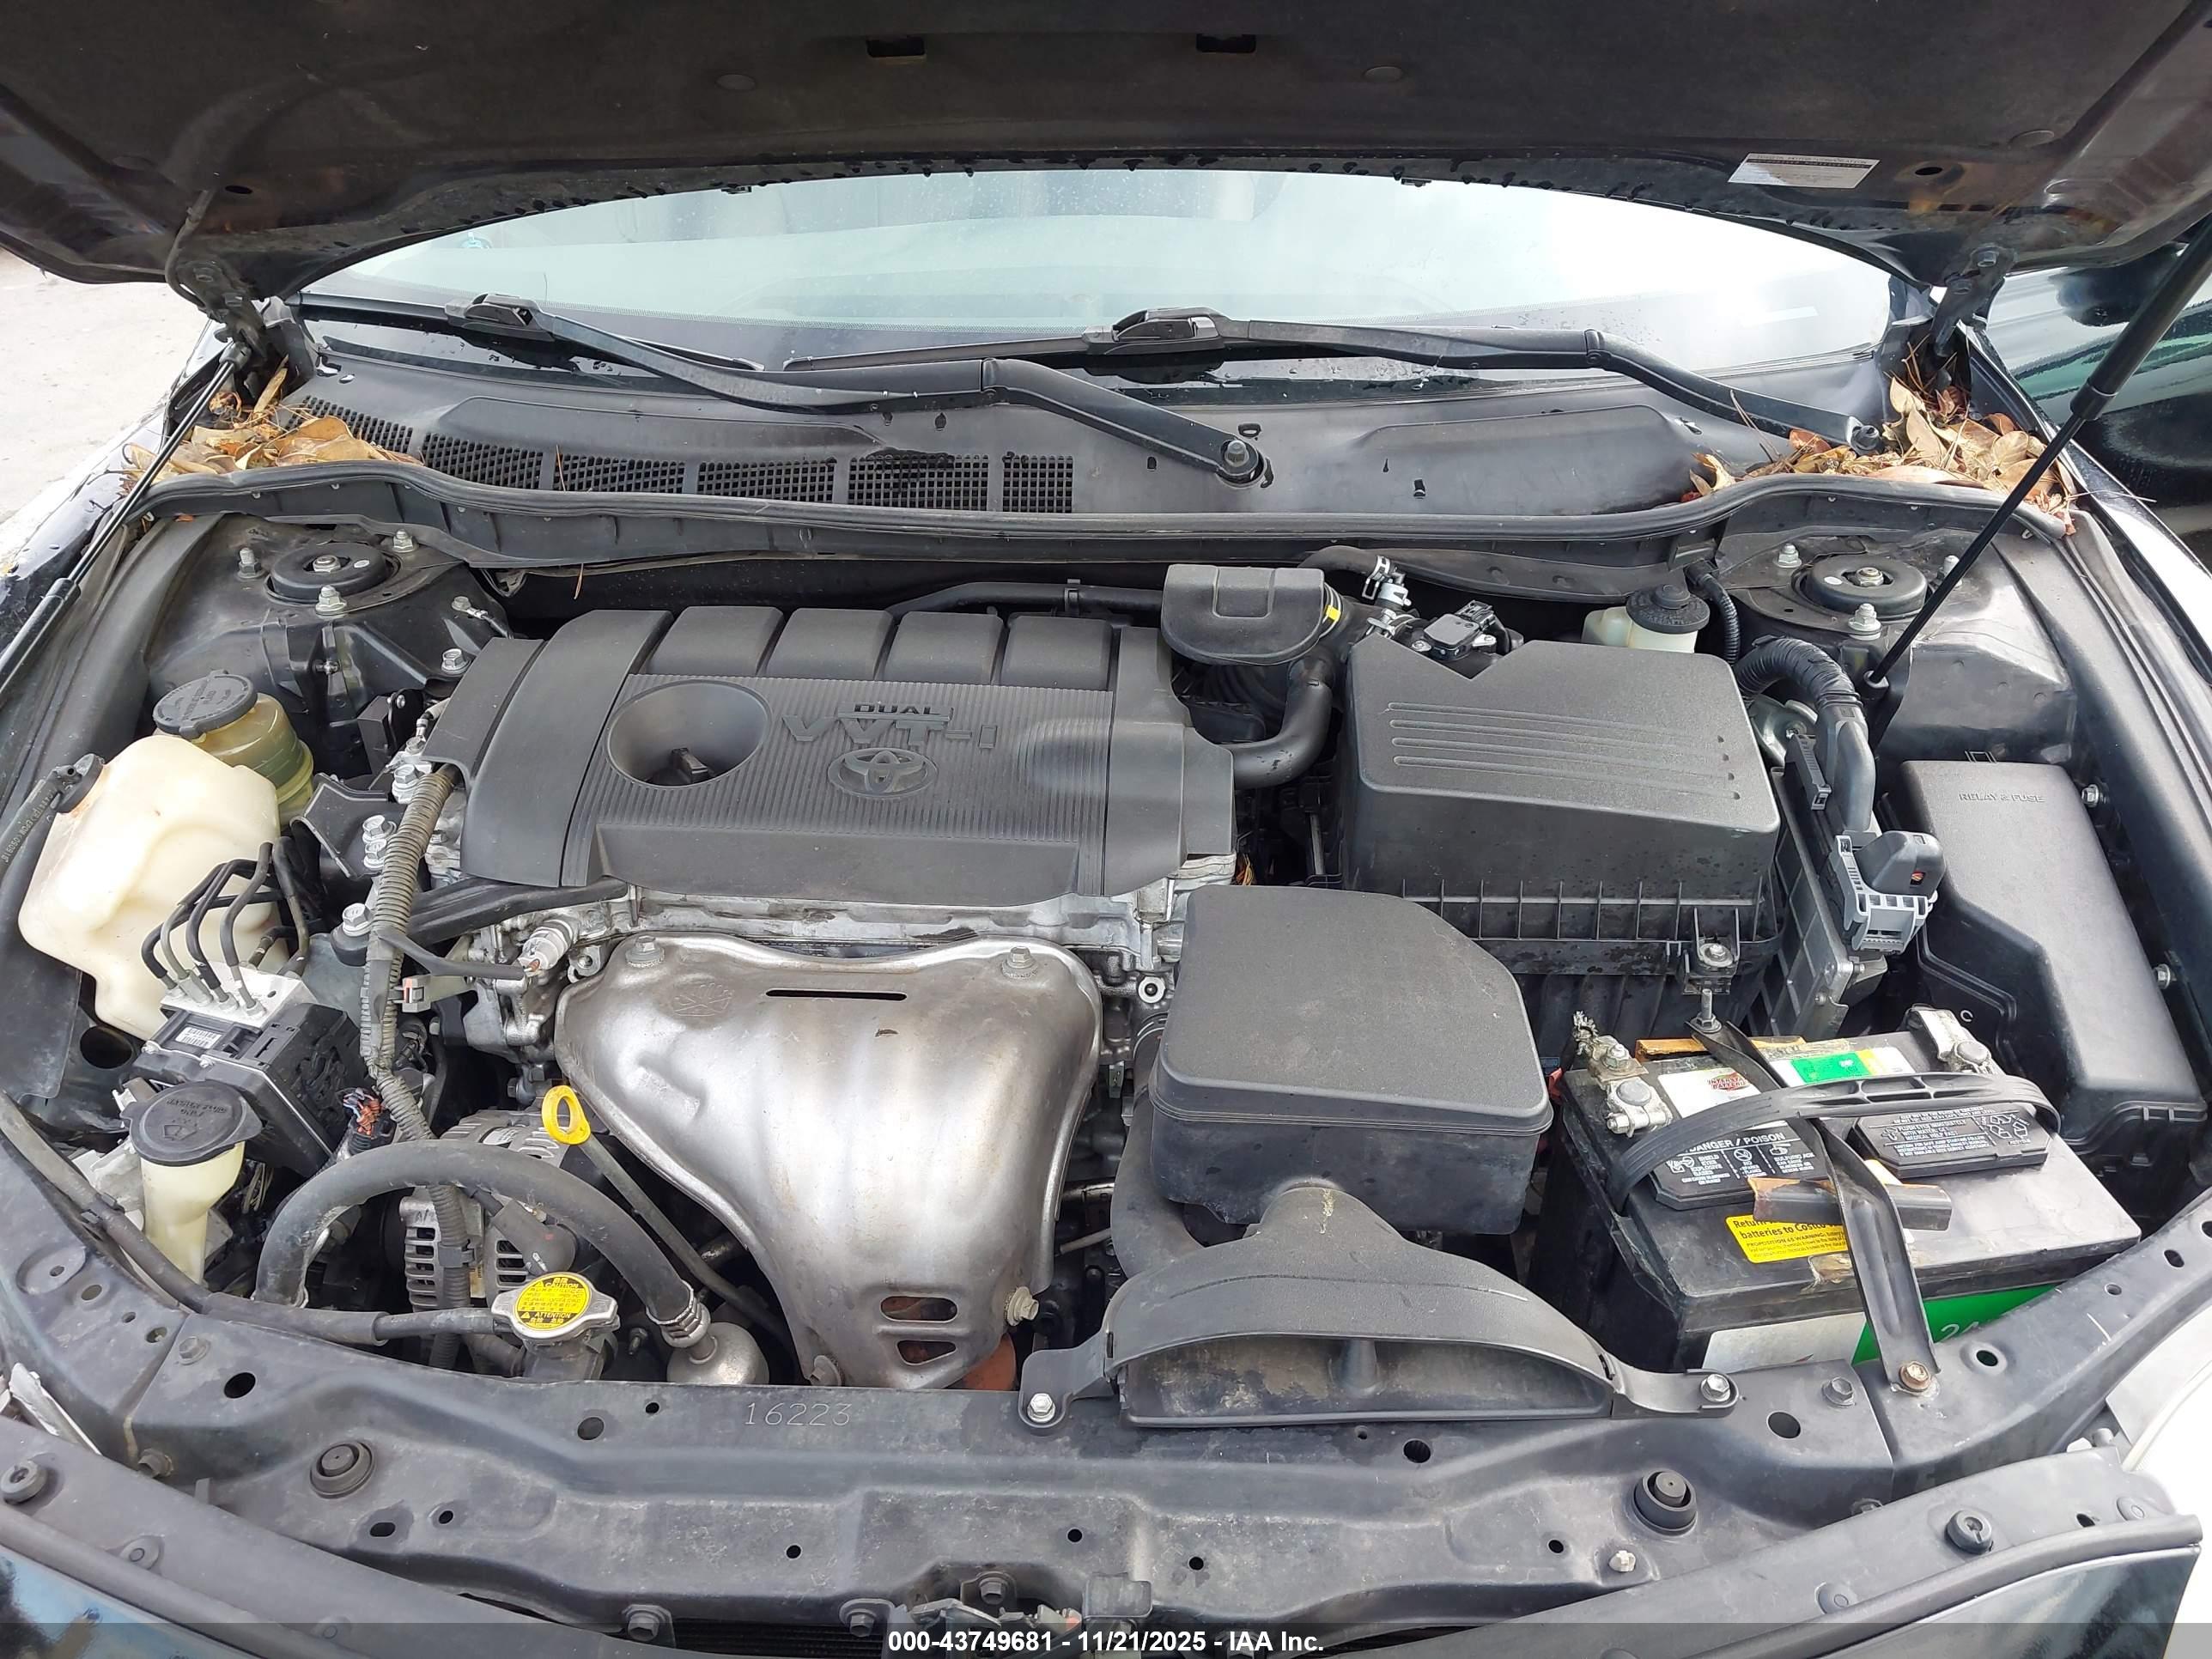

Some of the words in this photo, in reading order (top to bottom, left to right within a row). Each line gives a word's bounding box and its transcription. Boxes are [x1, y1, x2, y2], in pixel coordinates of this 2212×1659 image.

[854, 703, 942, 716] DUAL
[1958, 793, 1998, 802] RELAY
[2011, 793, 2046, 804] FUSE
[1743, 1132, 1786, 1145] POISON
[1740, 1228, 1783, 1239] batteries
[744, 1402, 853, 1426] 16223
